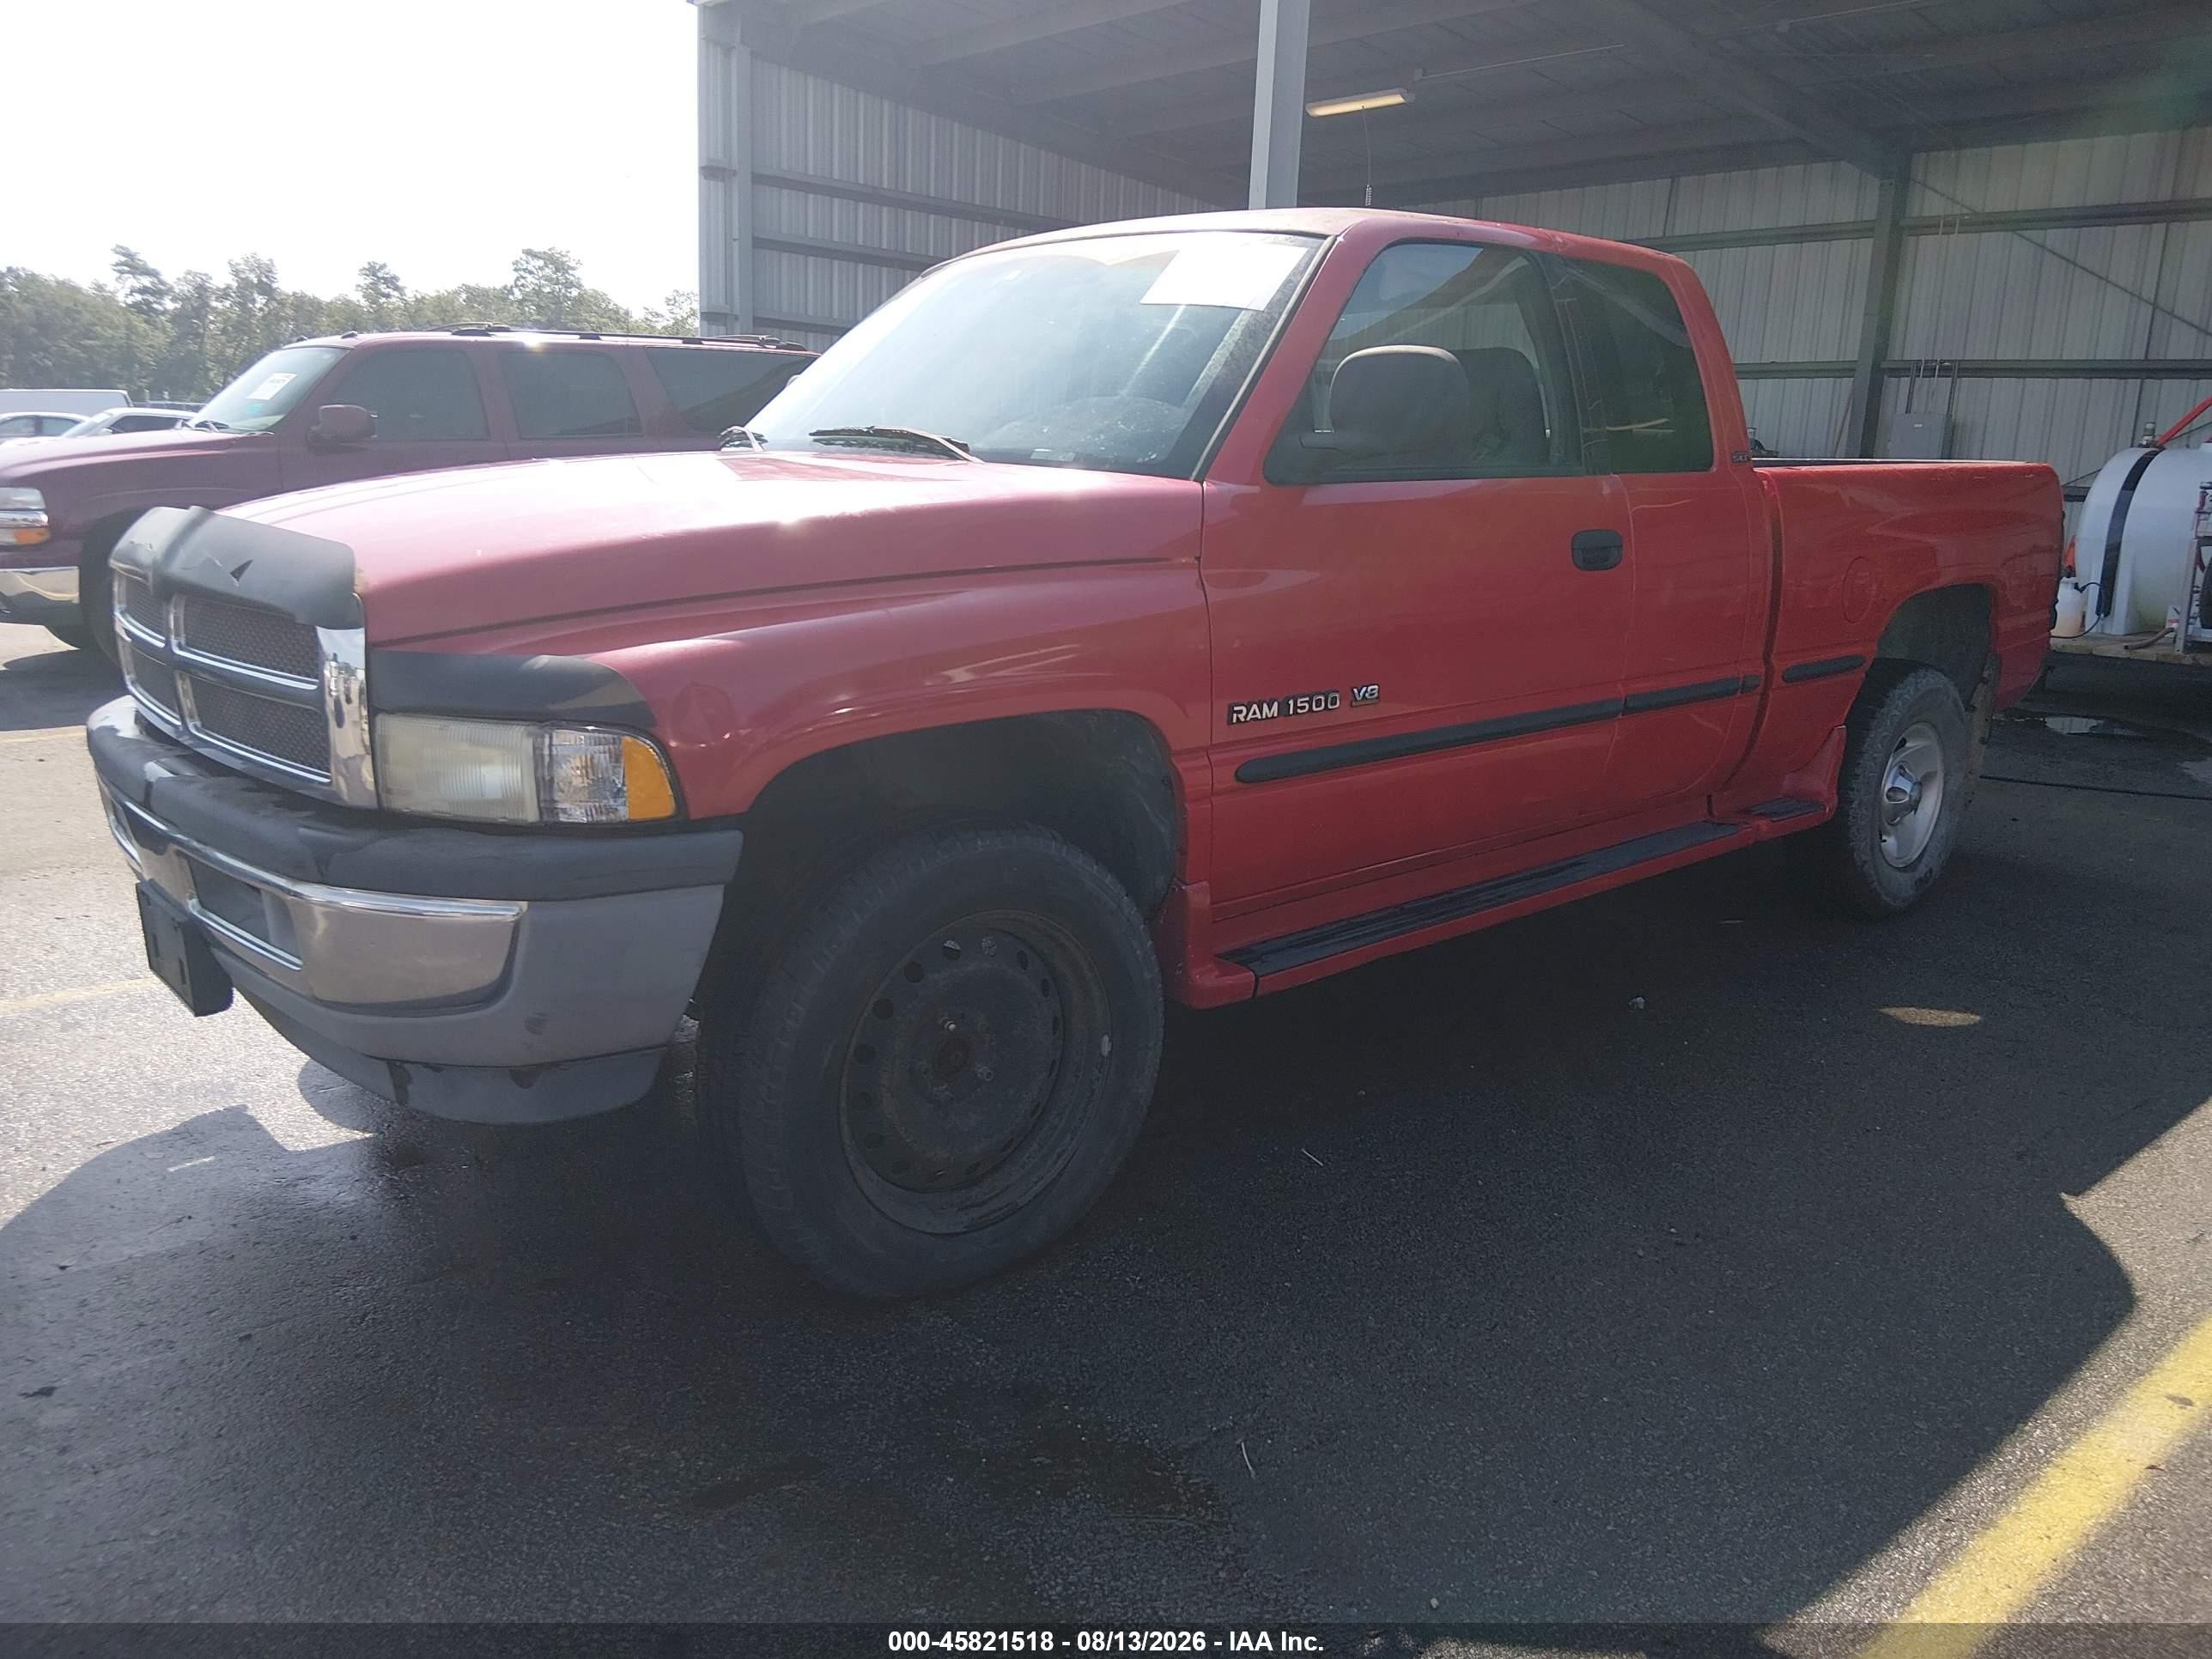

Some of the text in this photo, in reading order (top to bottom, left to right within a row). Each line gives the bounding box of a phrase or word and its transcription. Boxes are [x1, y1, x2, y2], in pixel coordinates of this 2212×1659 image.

[1231, 684, 1380, 723] RAM 1500 V8
